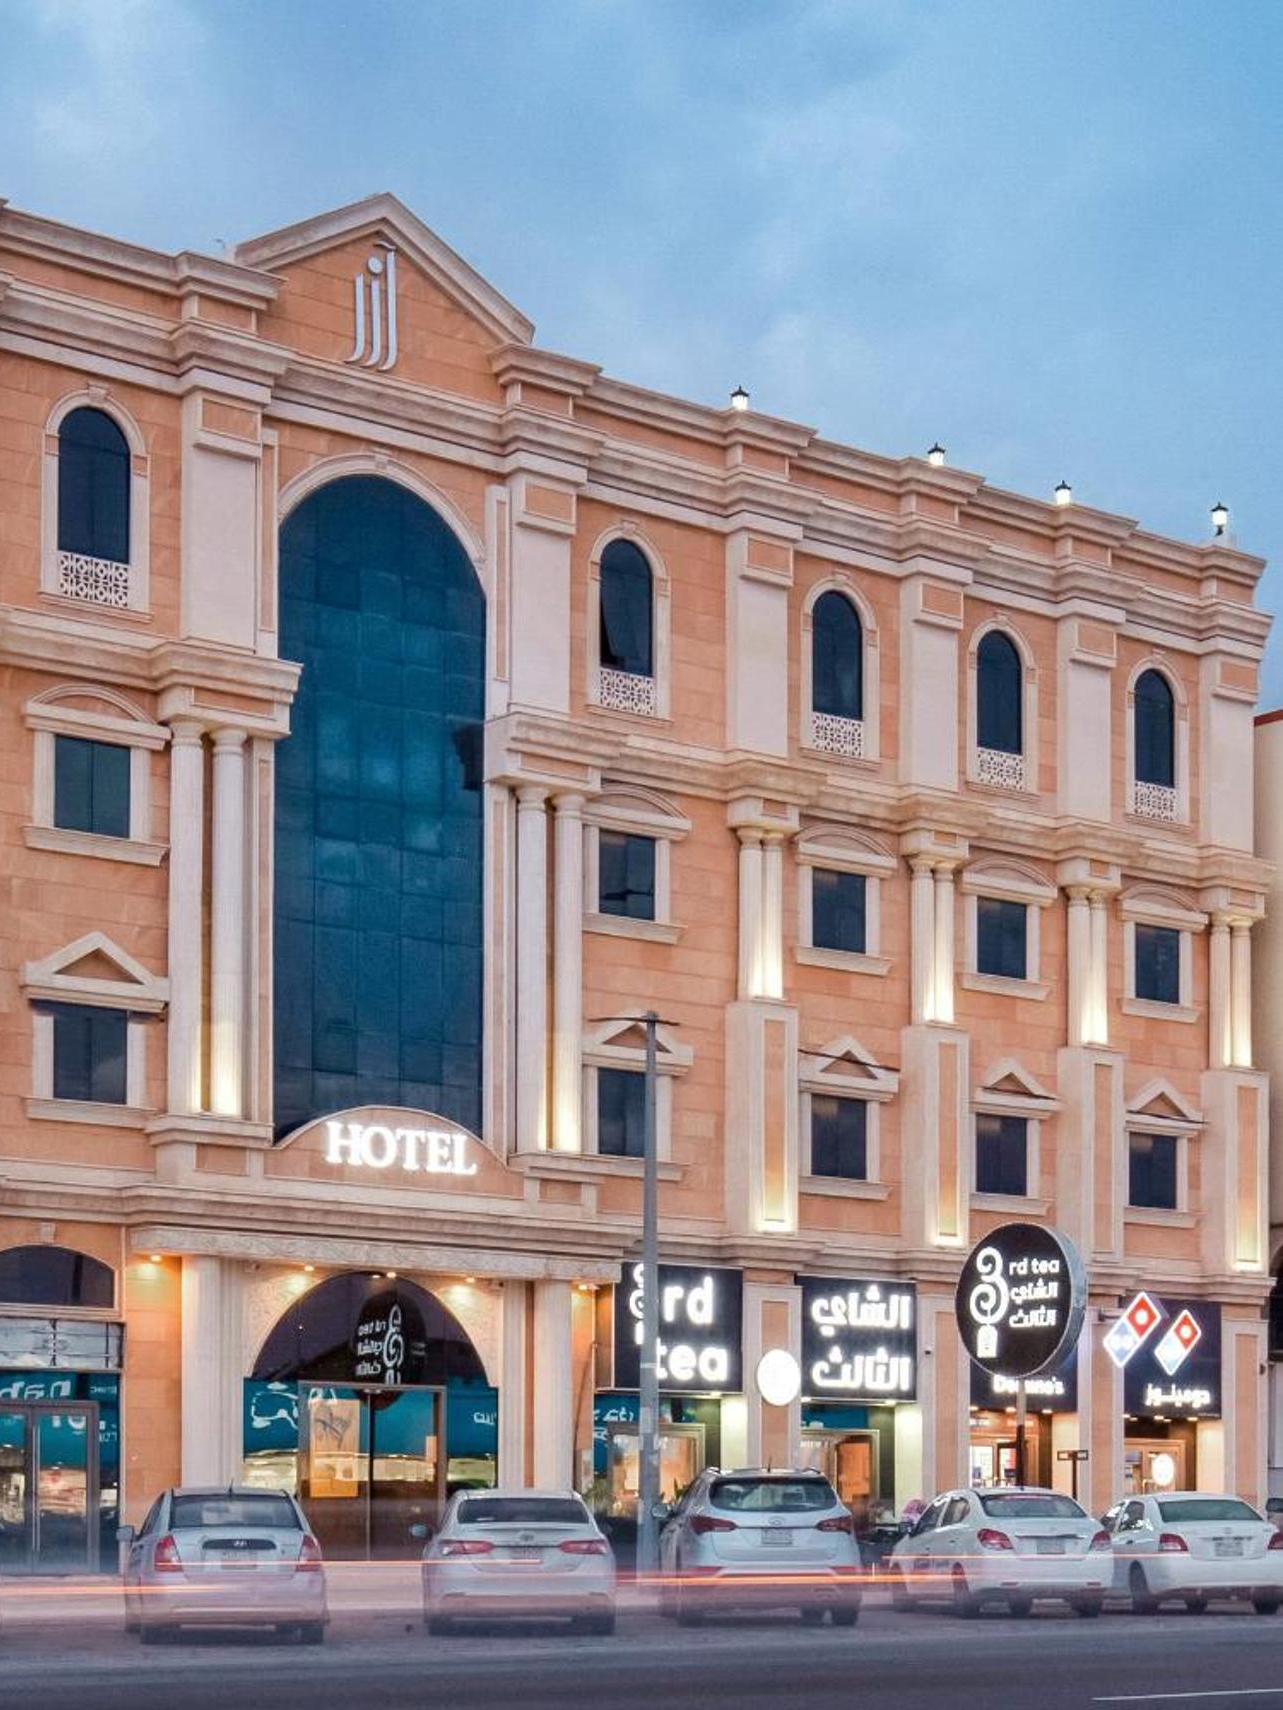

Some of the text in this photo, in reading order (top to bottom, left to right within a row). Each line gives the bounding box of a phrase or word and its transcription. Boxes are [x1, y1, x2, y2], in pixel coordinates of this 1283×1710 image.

[325, 1121, 478, 1175] HOTEL
[1031, 1258, 1060, 1275] tea
[811, 1285, 912, 1337] الشاي
[1010, 1278, 1059, 1304] الشاي
[1008, 1305, 1057, 1328] الثالث
[655, 1337, 728, 1382] tea
[811, 1346, 911, 1391] الثالث
